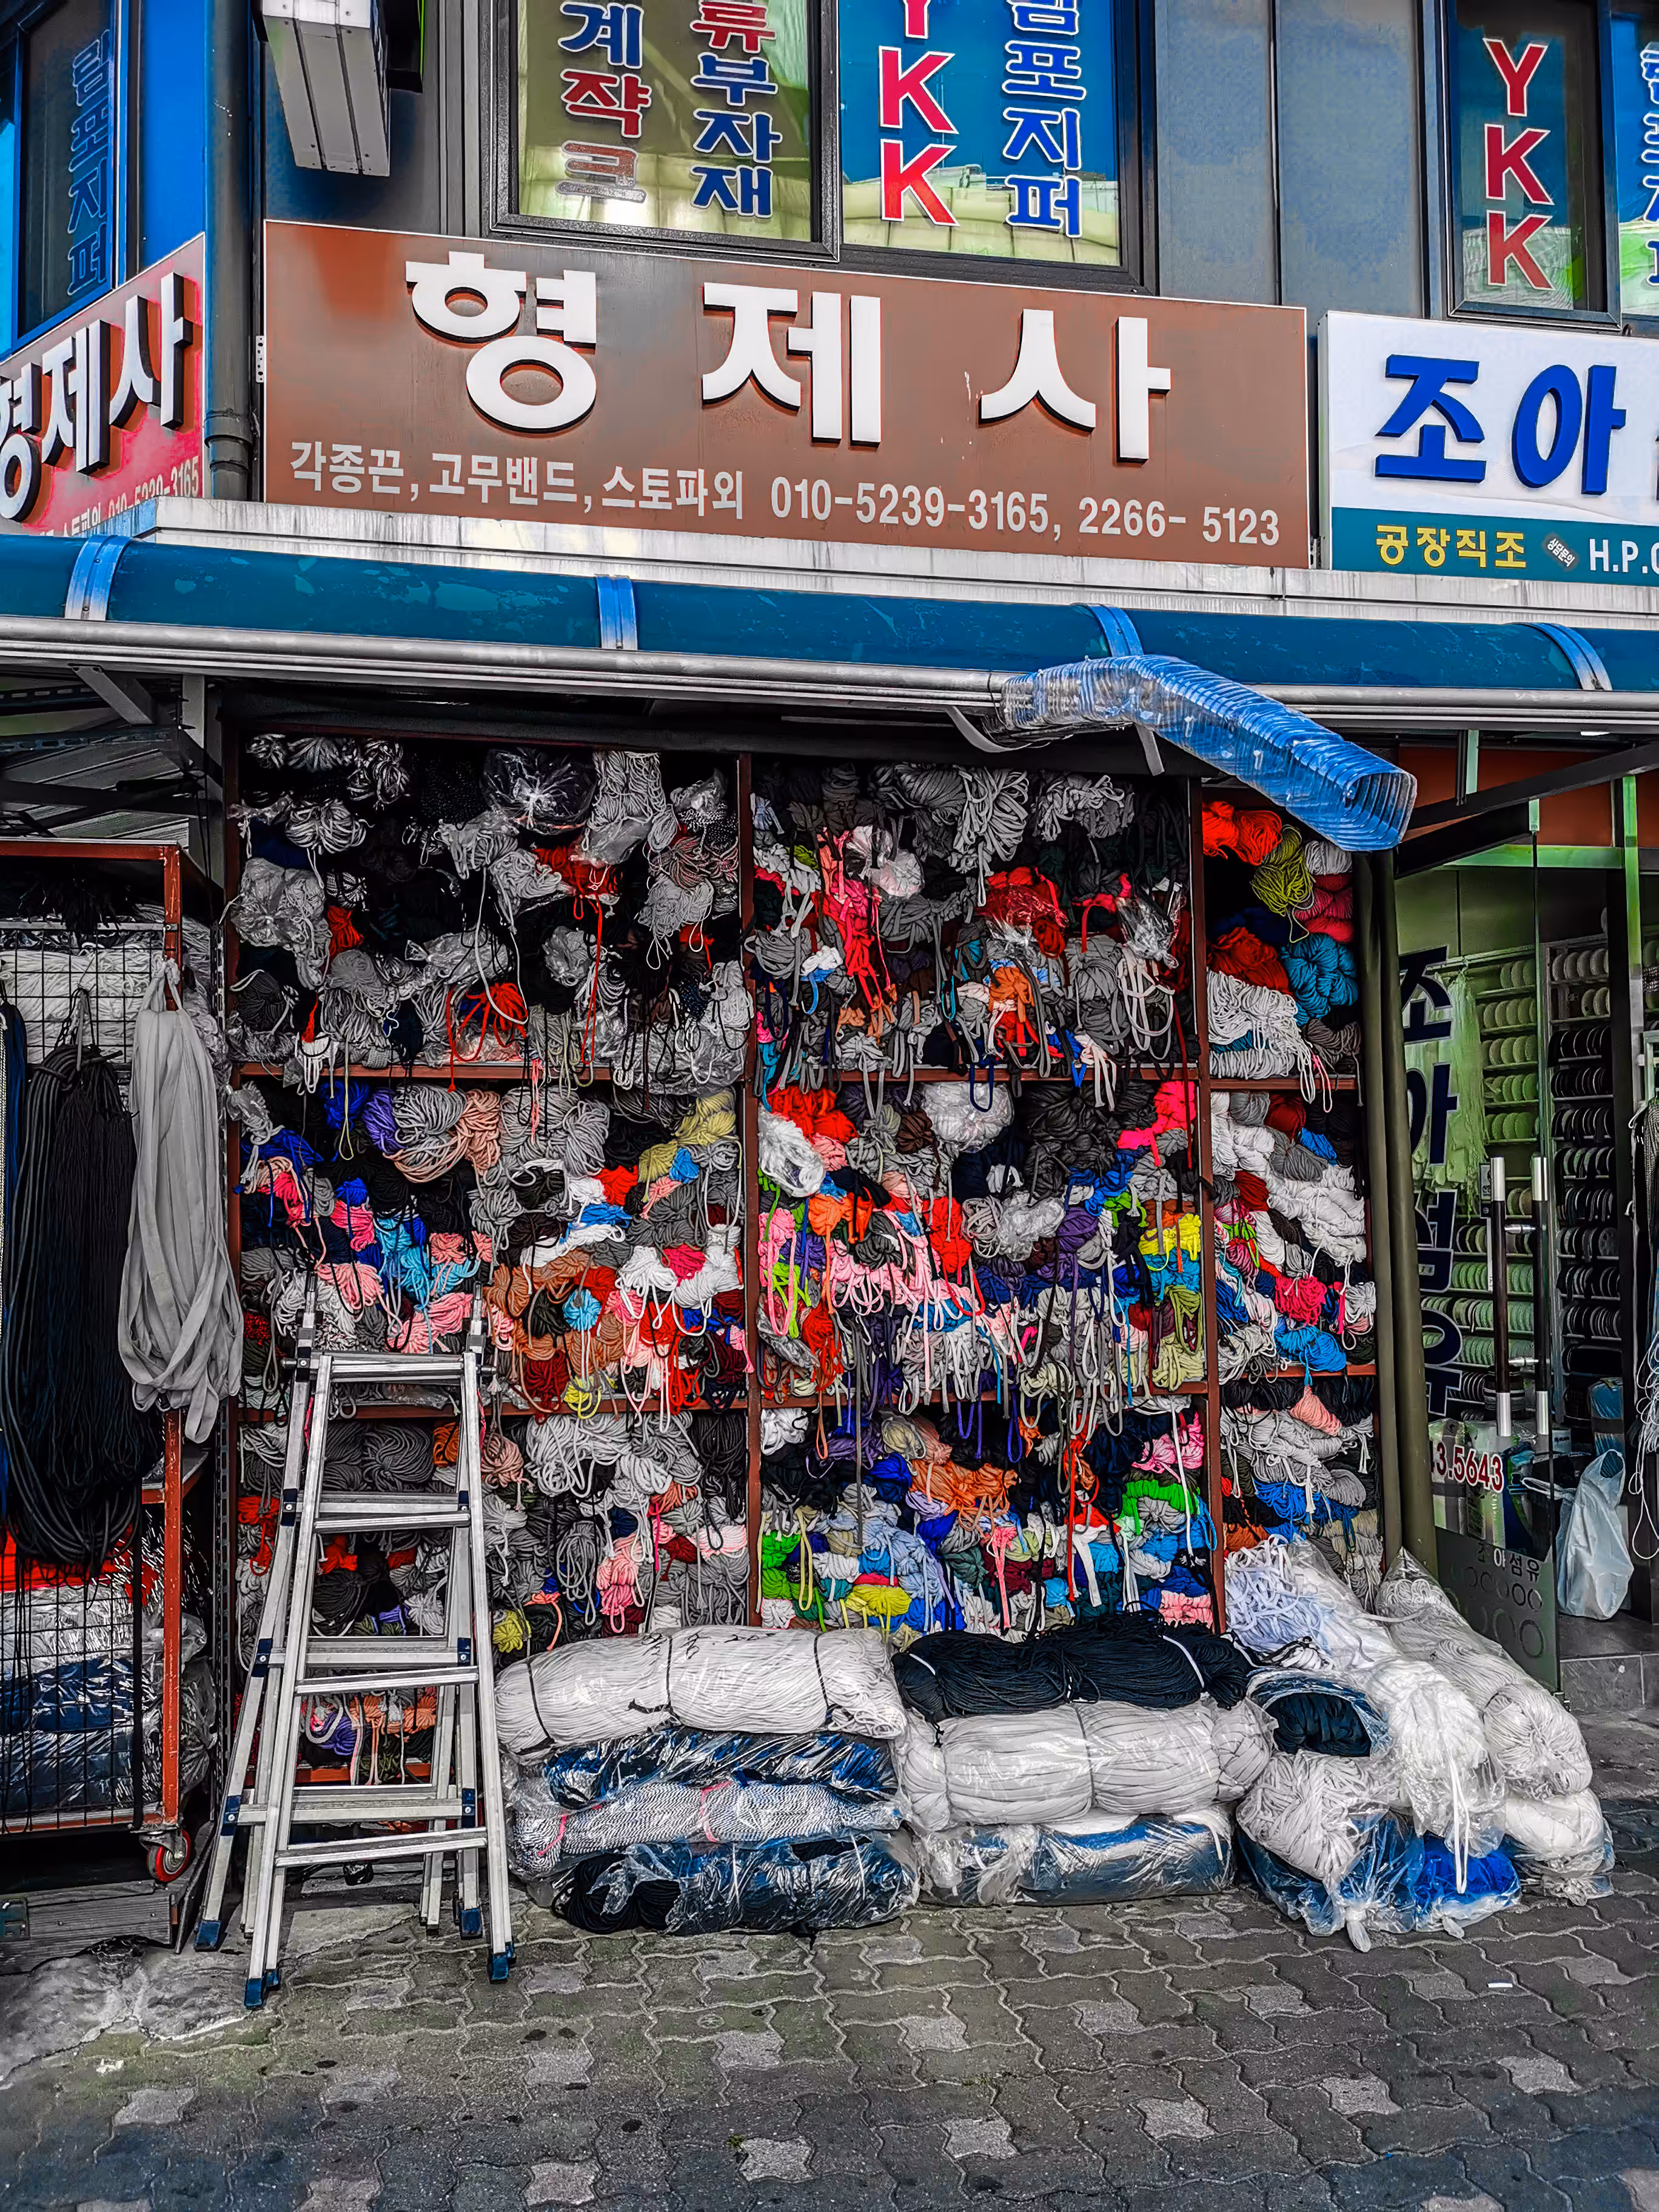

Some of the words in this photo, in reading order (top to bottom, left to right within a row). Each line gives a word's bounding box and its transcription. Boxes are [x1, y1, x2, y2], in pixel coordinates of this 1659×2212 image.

[1483, 37, 1555, 291] YKK
[1376, 525, 1527, 568] 공장직조
[1547, 538, 1575, 567] 상담문의
[1429, 1440, 1504, 1493] 3.5643
